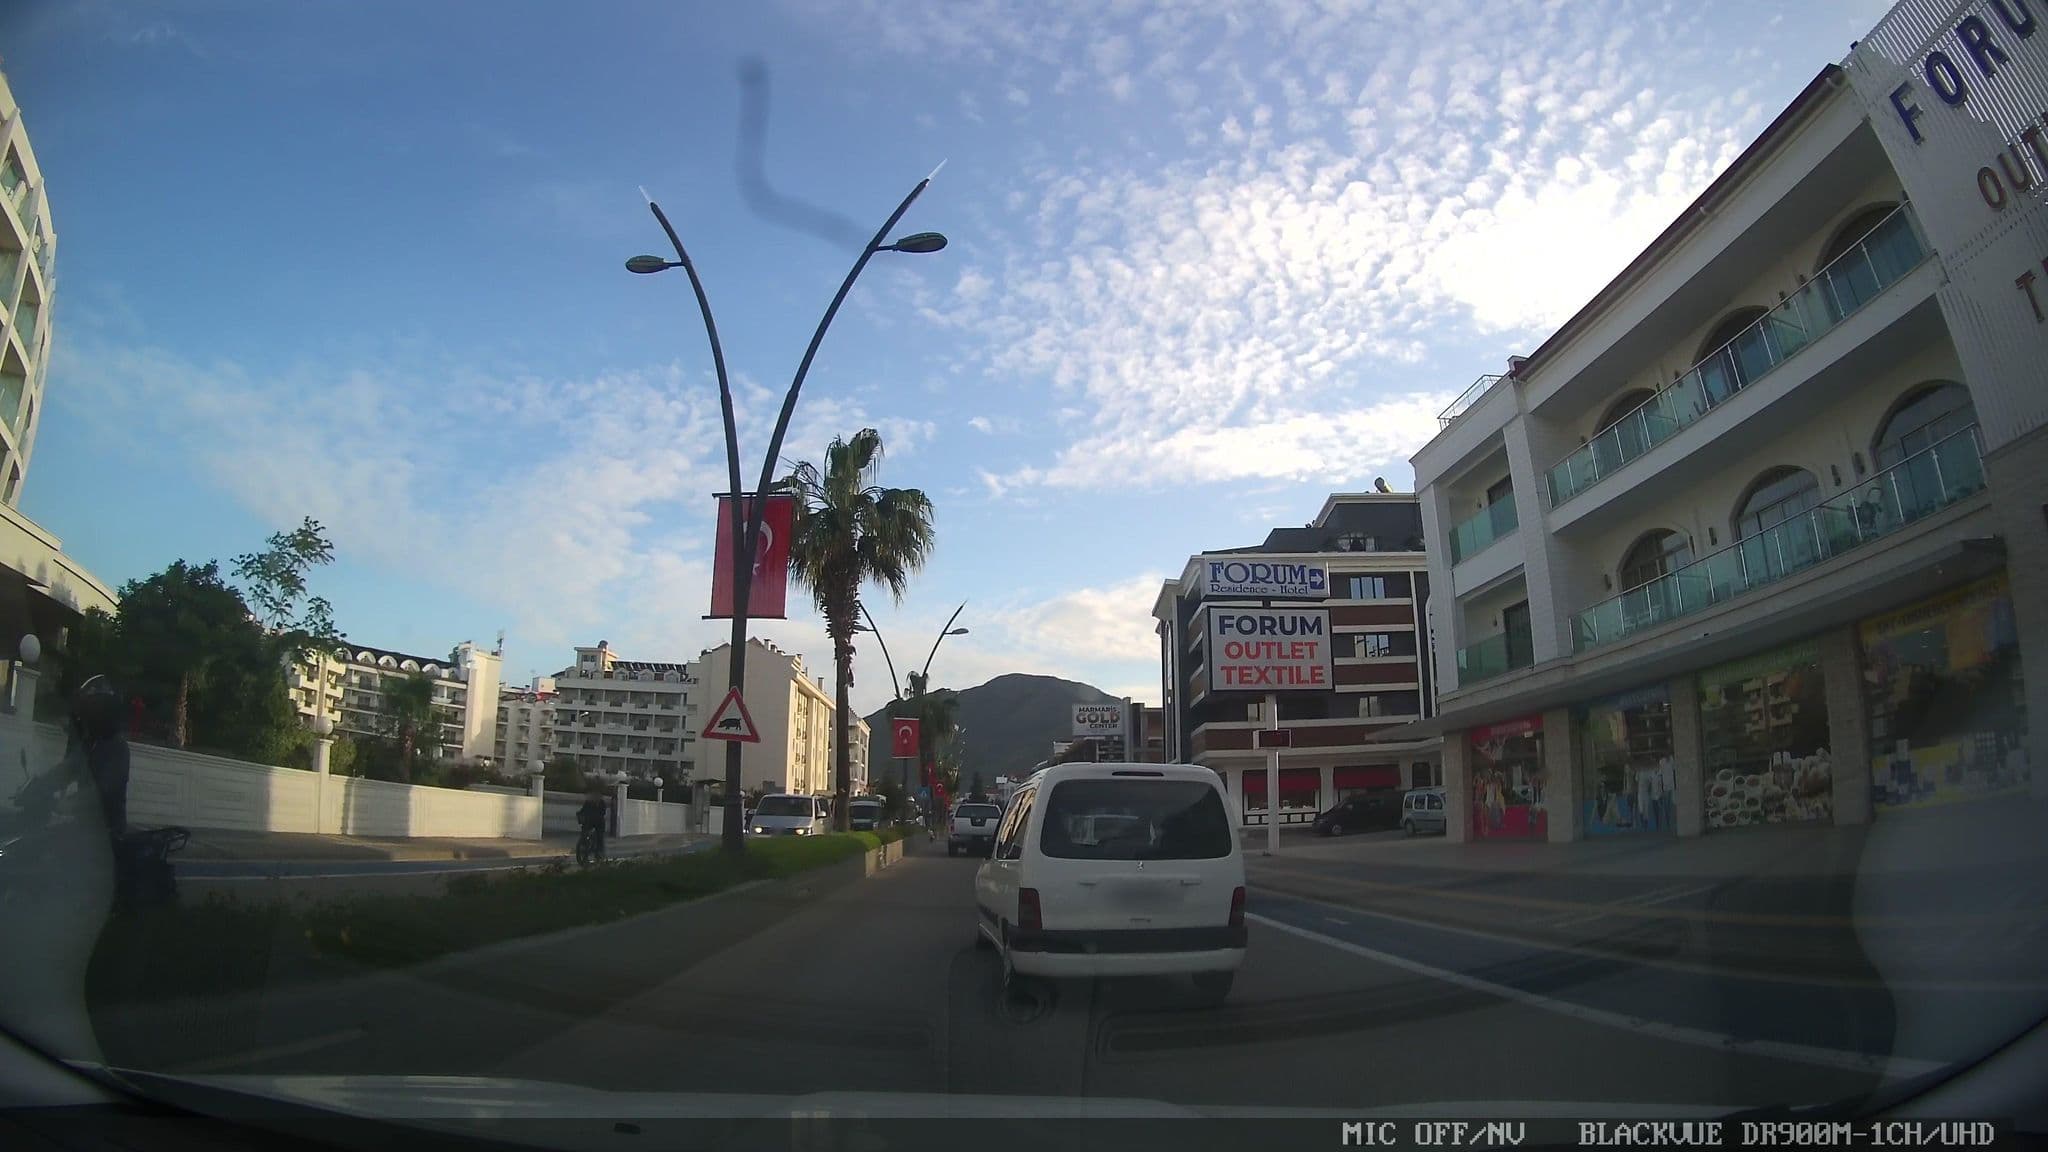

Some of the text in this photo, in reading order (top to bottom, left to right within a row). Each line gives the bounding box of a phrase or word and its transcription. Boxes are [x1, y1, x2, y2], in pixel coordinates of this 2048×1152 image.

[1209, 561, 1308, 585] FORUM
[1210, 583, 1268, 593] Residence
[1280, 585, 1309, 595] Hotel
[1218, 615, 1323, 636] FORUM
[1223, 640, 1319, 660] OUTLET
[1220, 665, 1326, 685] TEXTILE
[1075, 711, 1121, 724] GOLD
